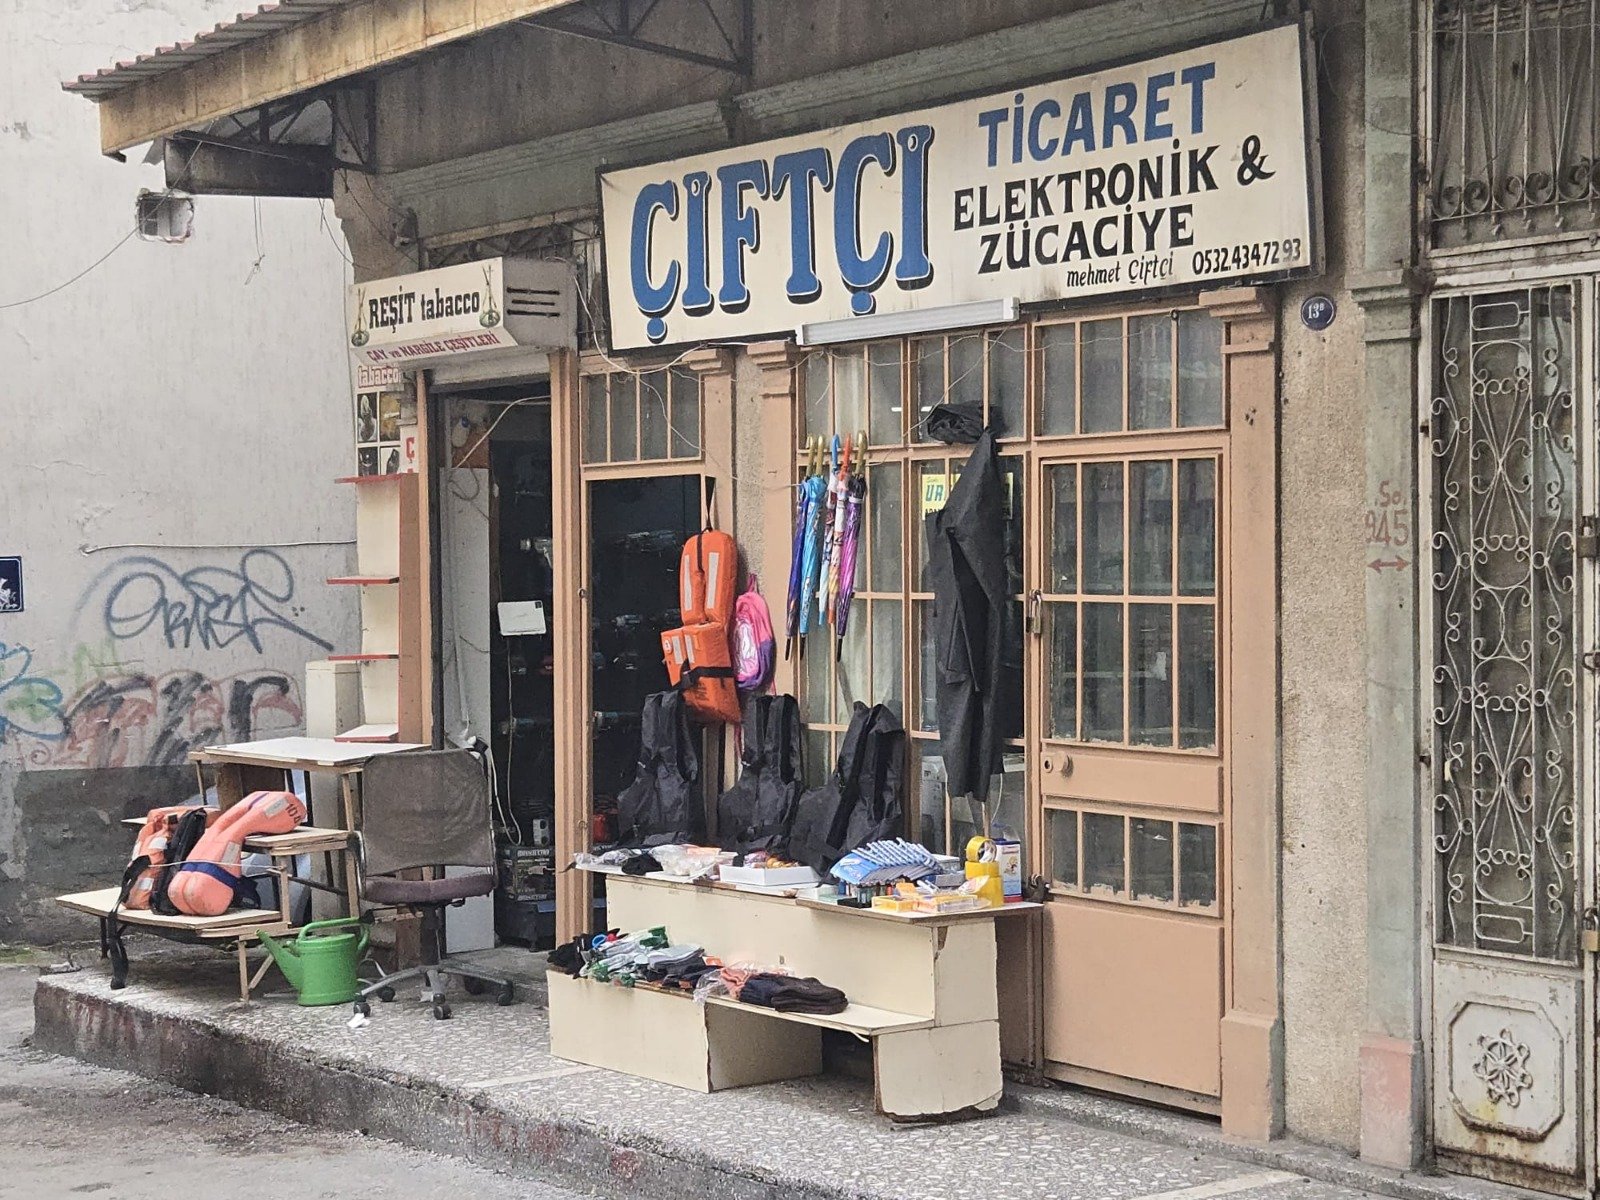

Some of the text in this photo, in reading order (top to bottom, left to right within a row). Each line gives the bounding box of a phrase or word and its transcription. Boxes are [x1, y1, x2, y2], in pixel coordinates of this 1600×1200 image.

[978, 61, 1216, 167] TİCARET
[953, 134, 1276, 232] ELEKTRONİK &
[977, 203, 1195, 275] ZÜCACİYE
[1066, 262, 1121, 288] mehmet
[368, 285, 480, 334] REŞİT tabacco
[366, 330, 502, 363] ÇAY ve NARGİLE ÇEŞİTLERİ
